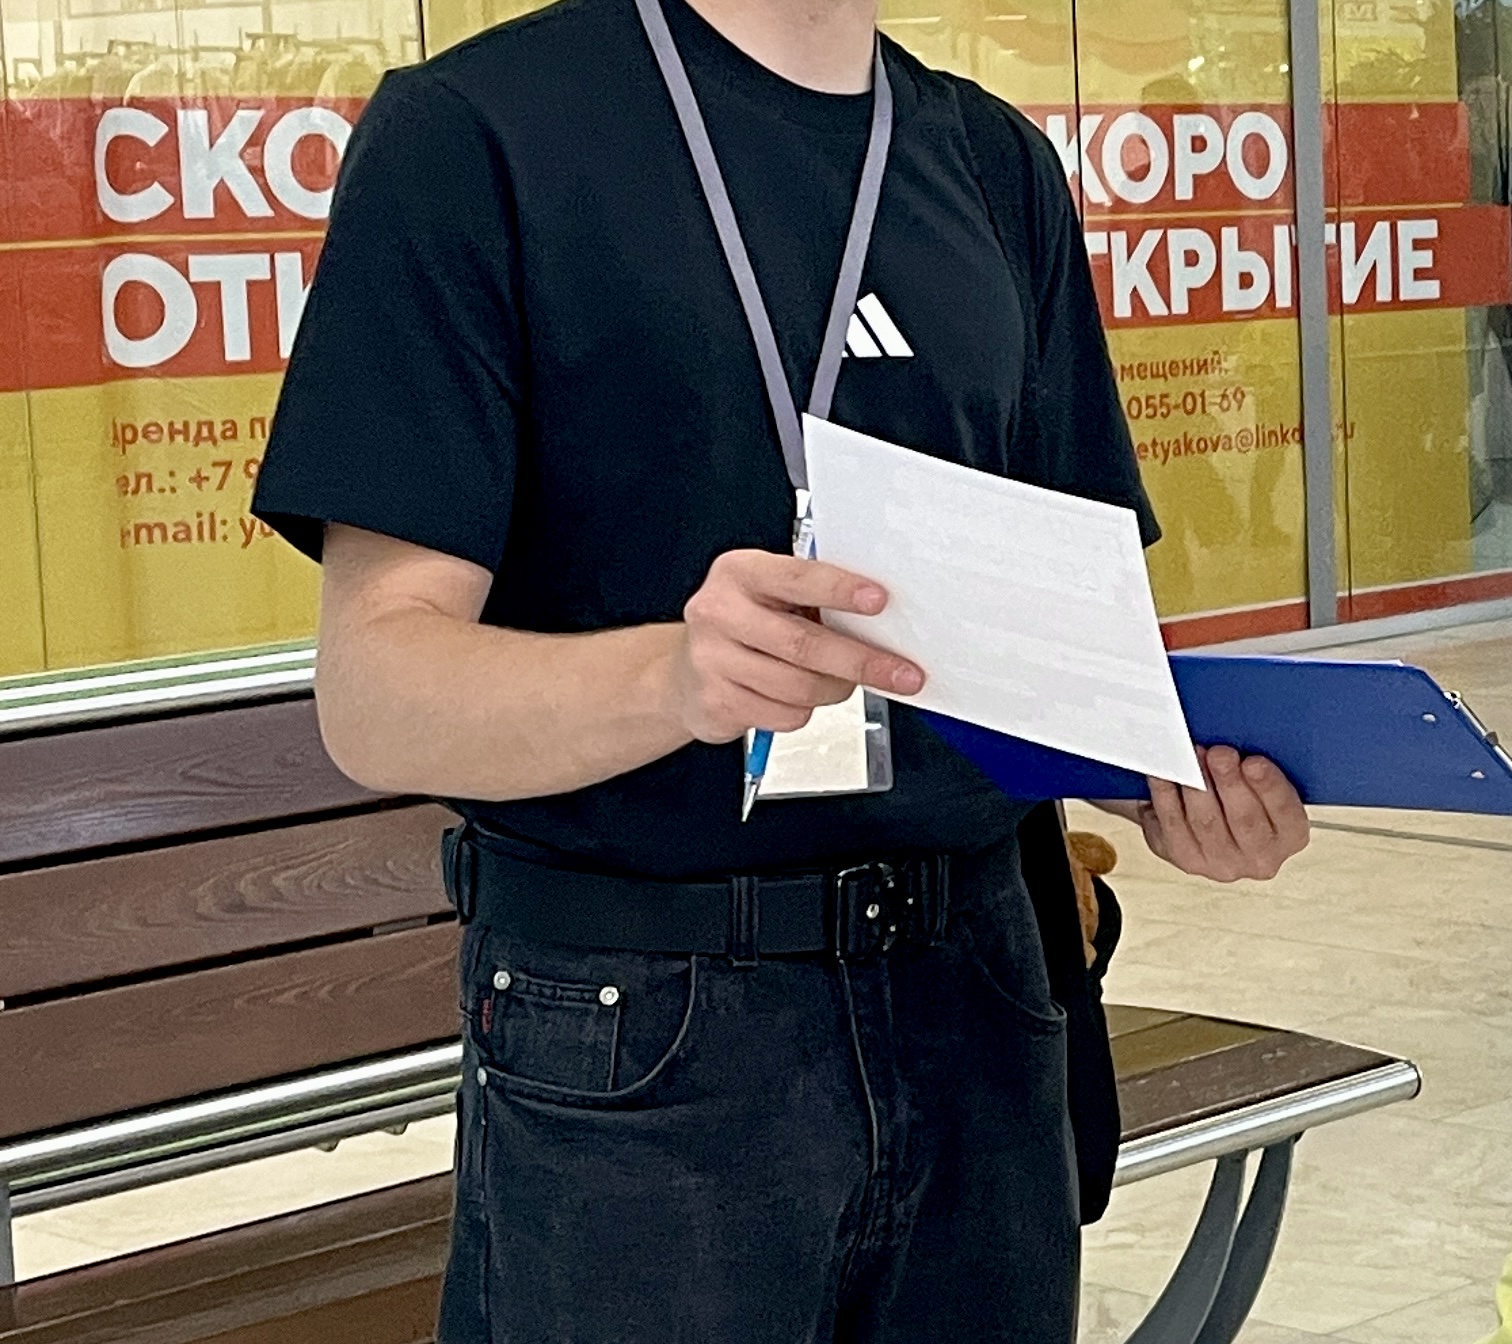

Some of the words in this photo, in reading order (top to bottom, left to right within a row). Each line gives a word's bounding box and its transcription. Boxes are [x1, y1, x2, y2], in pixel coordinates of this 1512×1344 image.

[96, 106, 354, 223] СКО
[1046, 111, 1288, 206] КОРО
[1084, 219, 1441, 319] КРЫИЕ
[115, 469, 178, 497] ел.:
[188, 460, 234, 492] +7
[119, 511, 229, 550] mail:
